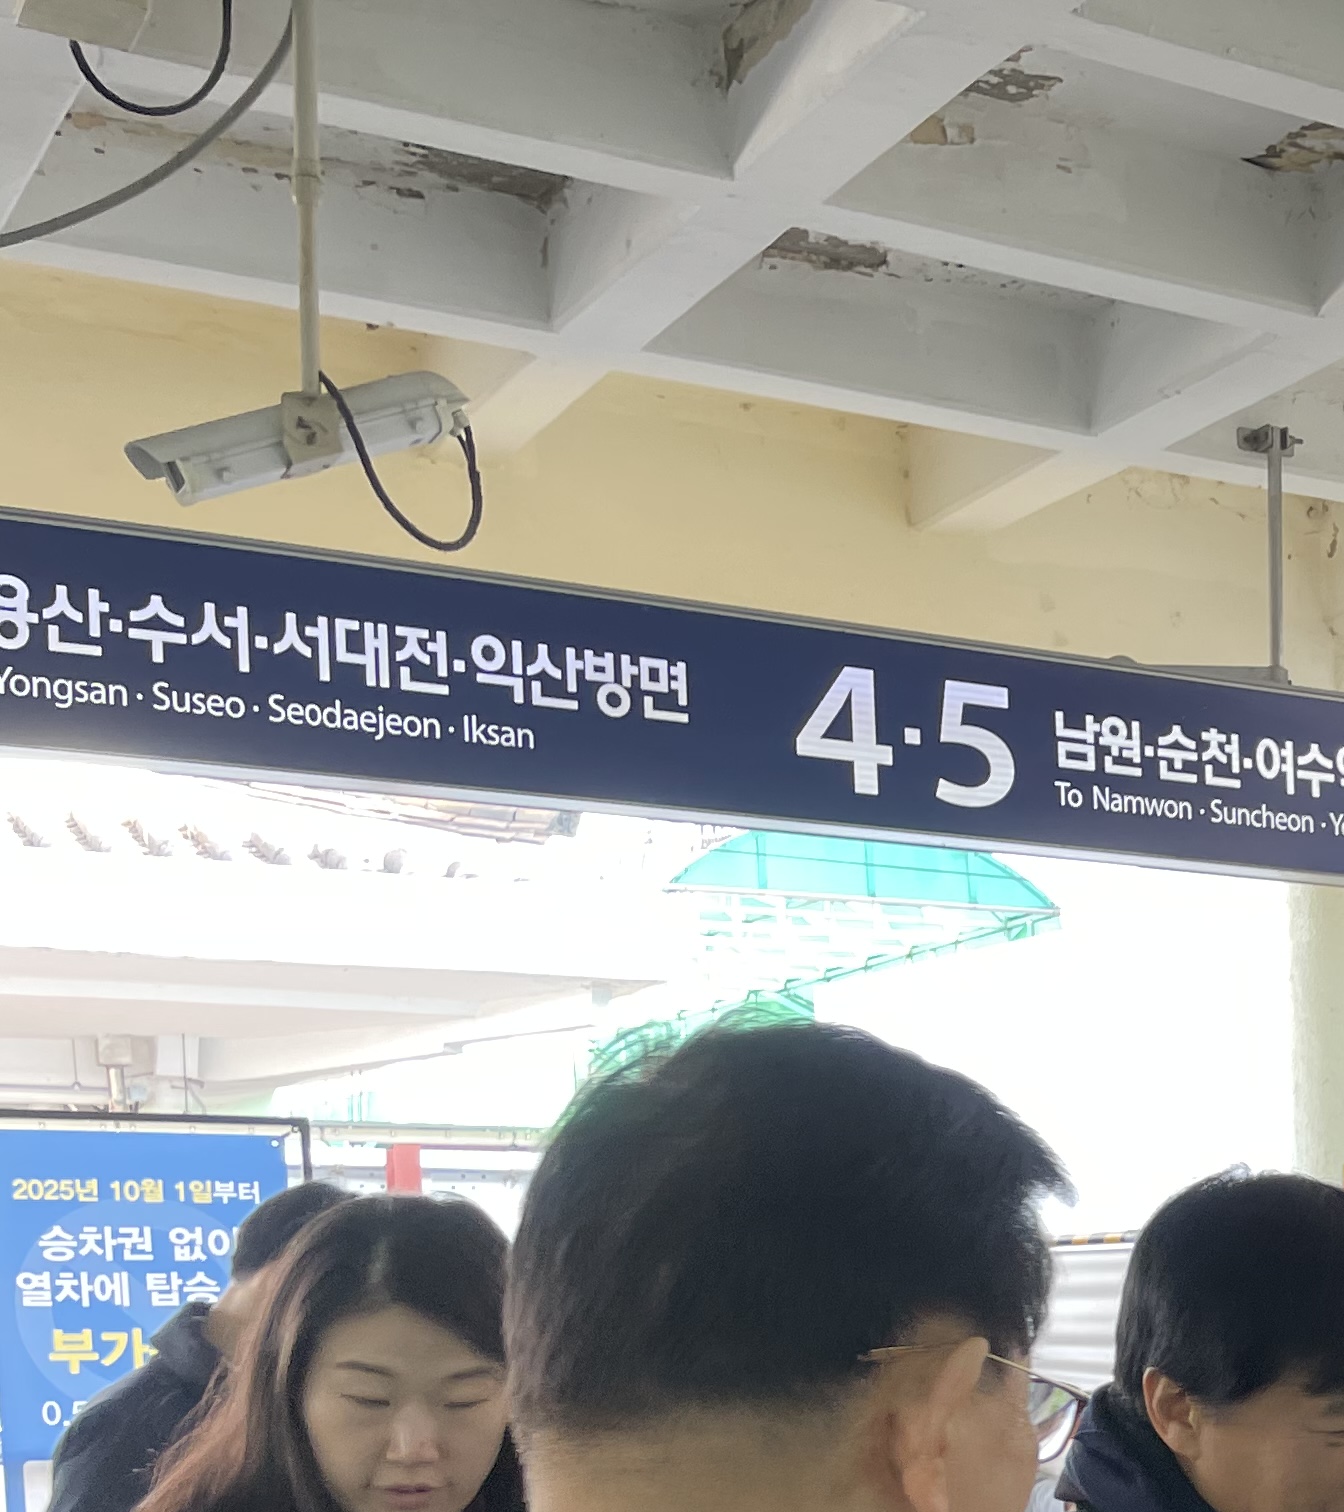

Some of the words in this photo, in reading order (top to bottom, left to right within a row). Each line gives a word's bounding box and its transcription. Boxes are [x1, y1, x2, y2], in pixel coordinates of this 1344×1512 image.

[0, 666, 128, 709] Yongsan
[152, 681, 246, 718] Suseo
[268, 693, 441, 740] Seodaejeon
[462, 715, 535, 750] Iksan
[1054, 780, 1082, 808] To
[1092, 783, 1193, 822] Namwon
[1210, 799, 1315, 834] Suncheon
[11, 1178, 99, 1203] 2025년
[110, 1178, 164, 1204] 10월
[175, 1179, 261, 1205] 1일부터
[38, 1225, 154, 1262] 승차권
[15, 1271, 130, 1307] 열차에
